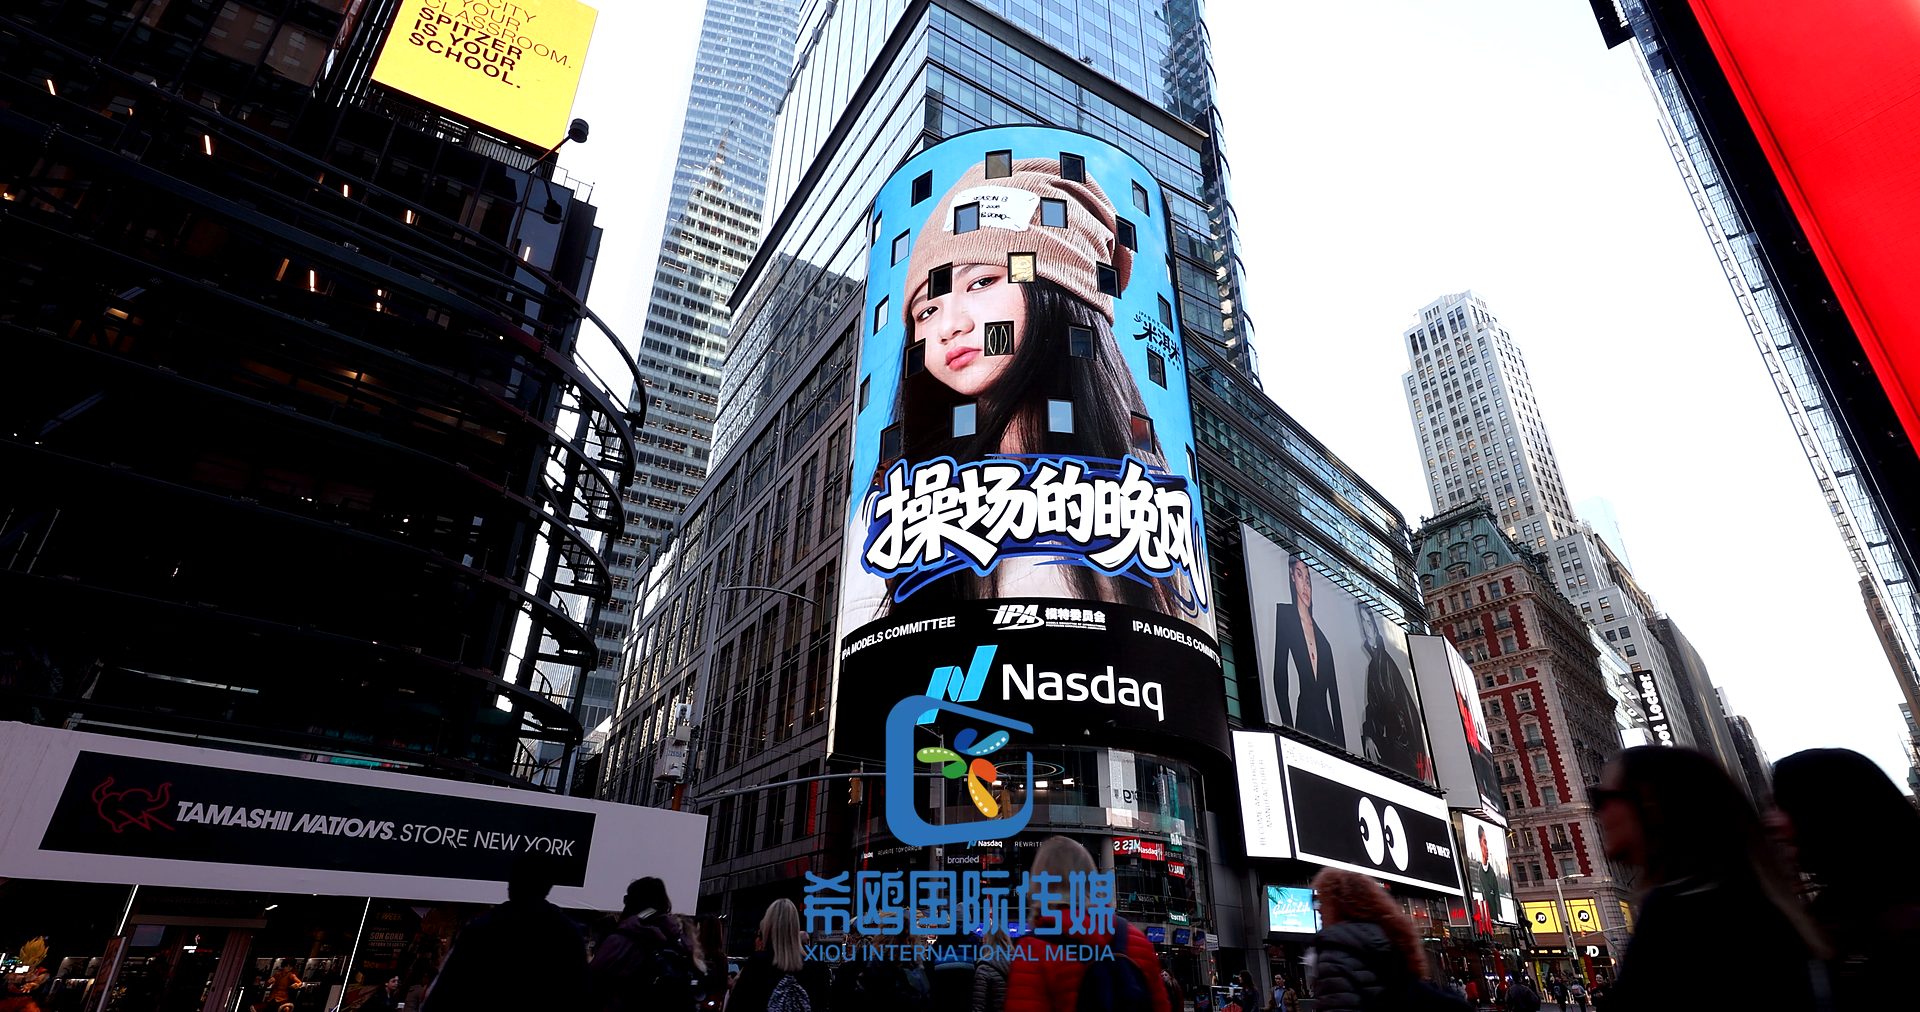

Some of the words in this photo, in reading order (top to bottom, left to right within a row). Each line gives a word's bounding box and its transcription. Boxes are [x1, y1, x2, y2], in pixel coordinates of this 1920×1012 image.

[463, 0, 521, 31] YOUR
[487, 0, 537, 23] CITY
[414, 19, 439, 37] IS
[449, 32, 516, 71] YOUR
[419, 7, 523, 60] SPITZER
[425, 0, 572, 69] CLASSROOM.
[409, 32, 521, 89] SCHOOL.
[865, 459, 1207, 607] 操场的晚风
[993, 604, 1039, 625] IPA
[1132, 620, 1153, 635] IPA
[1153, 625, 1192, 647] MODELS
[851, 632, 883, 654] MODELS
[885, 616, 956, 640] COMMITTEE
[1002, 663, 1165, 722] Nasdaq
[176, 801, 293, 831] TAMASHII
[293, 813, 395, 840] NATIONS
[400, 823, 469, 849] STORE
[474, 831, 520, 852] NEW
[523, 835, 576, 857] YORK
[978, 840, 1003, 848] Nasdaq
[947, 854, 980, 864] branded
[1586, 945, 1600, 958] JD
